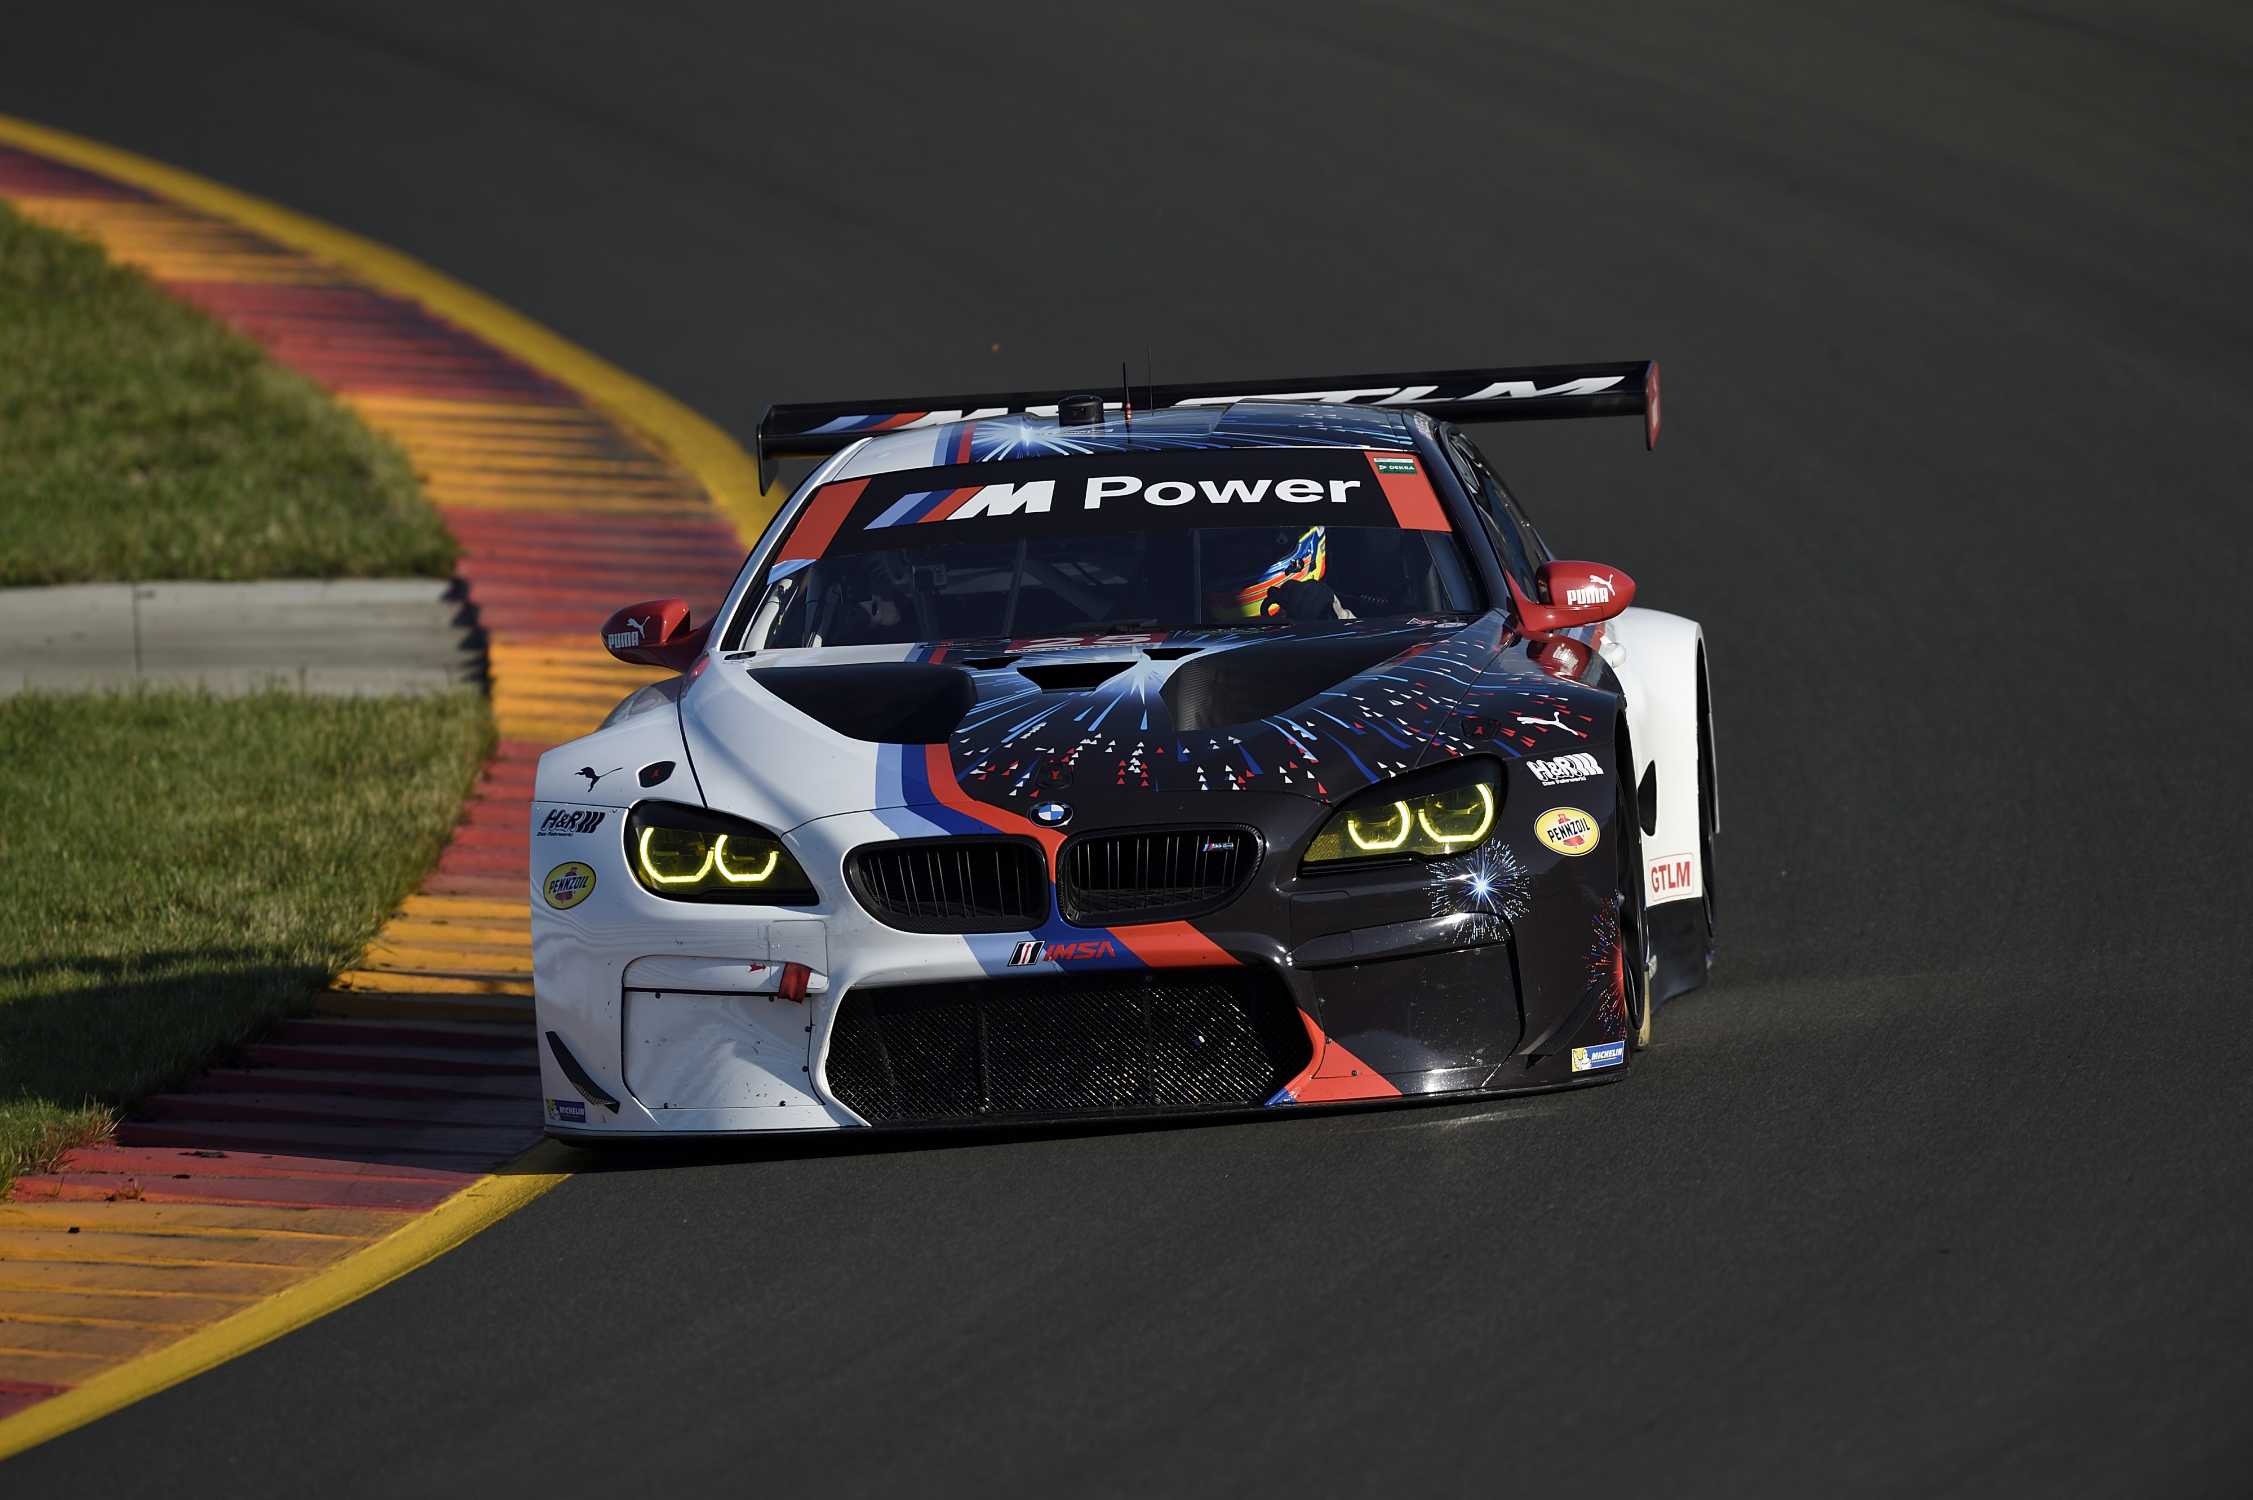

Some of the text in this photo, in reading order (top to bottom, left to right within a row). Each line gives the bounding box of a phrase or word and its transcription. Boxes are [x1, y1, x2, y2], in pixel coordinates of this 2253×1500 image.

[946, 475, 1361, 521] M Power
[1566, 586, 1609, 606] PUMA
[607, 631, 639, 649] PUMA
[1546, 818, 1591, 843] PENNZOIL
[548, 876, 590, 894] PENNZOIL
[1651, 861, 1690, 892] GTLM
[1043, 939, 1118, 961] IMSA
[1591, 1047, 1623, 1061] MICHELIN
